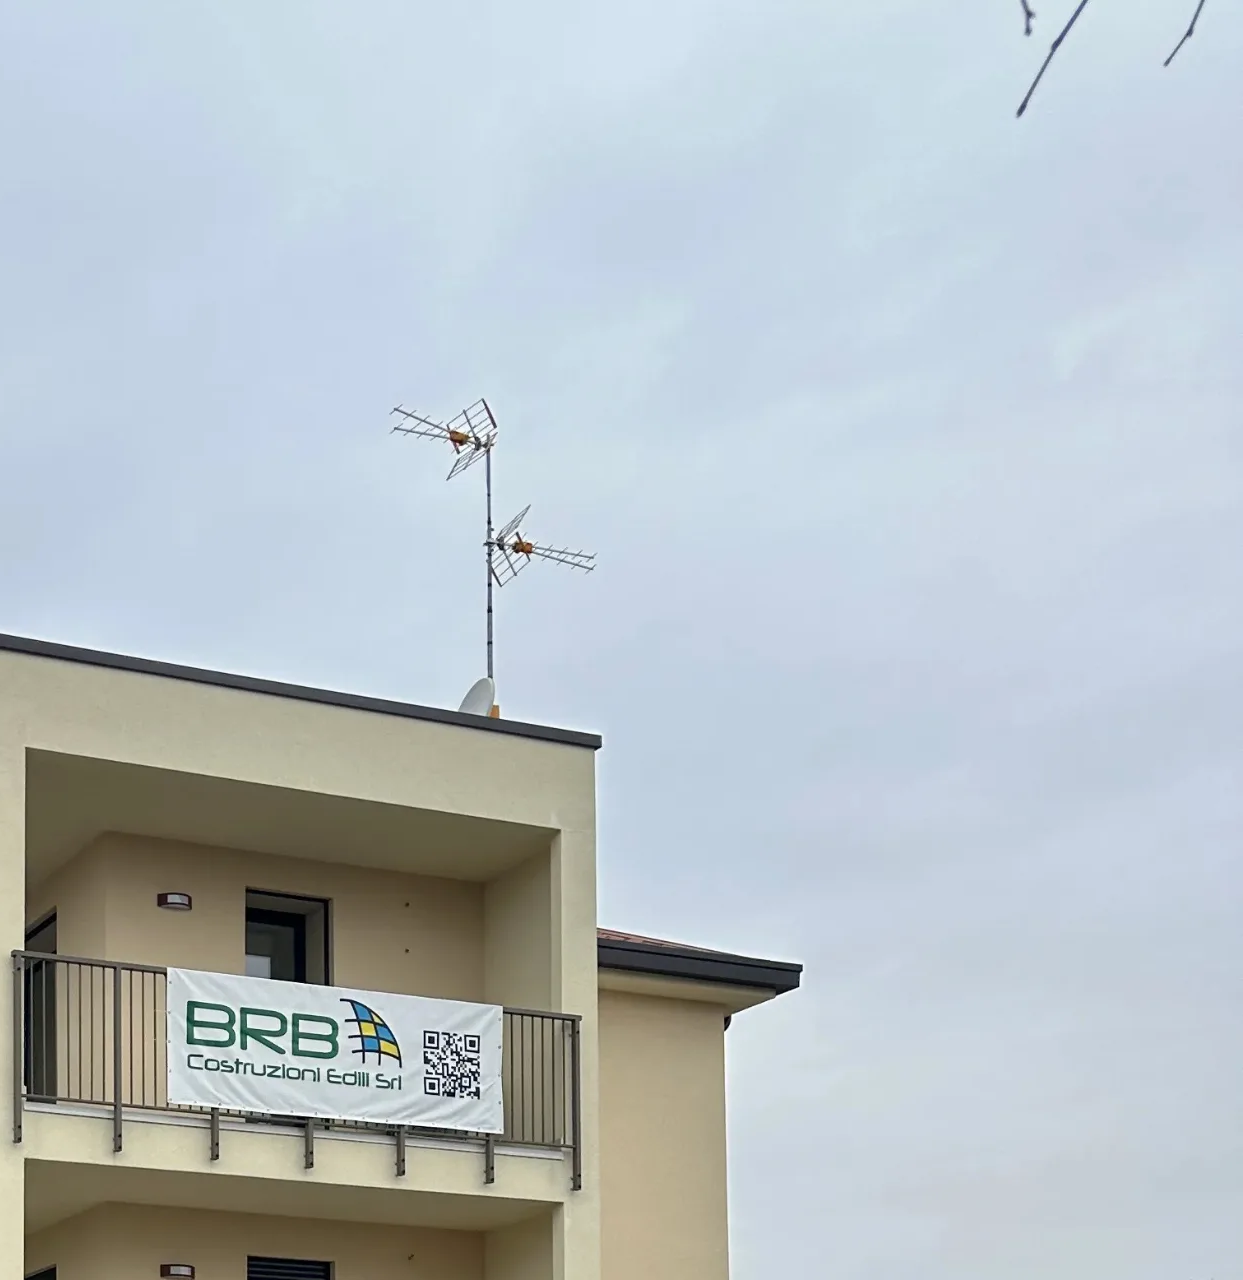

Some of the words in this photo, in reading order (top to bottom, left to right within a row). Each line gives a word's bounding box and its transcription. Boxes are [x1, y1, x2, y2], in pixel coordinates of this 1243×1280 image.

[186, 1000, 339, 1060] BRB
[187, 1054, 321, 1083] Costruzioni
[326, 1068, 370, 1088] Edili
[375, 1073, 403, 1091] Srl
